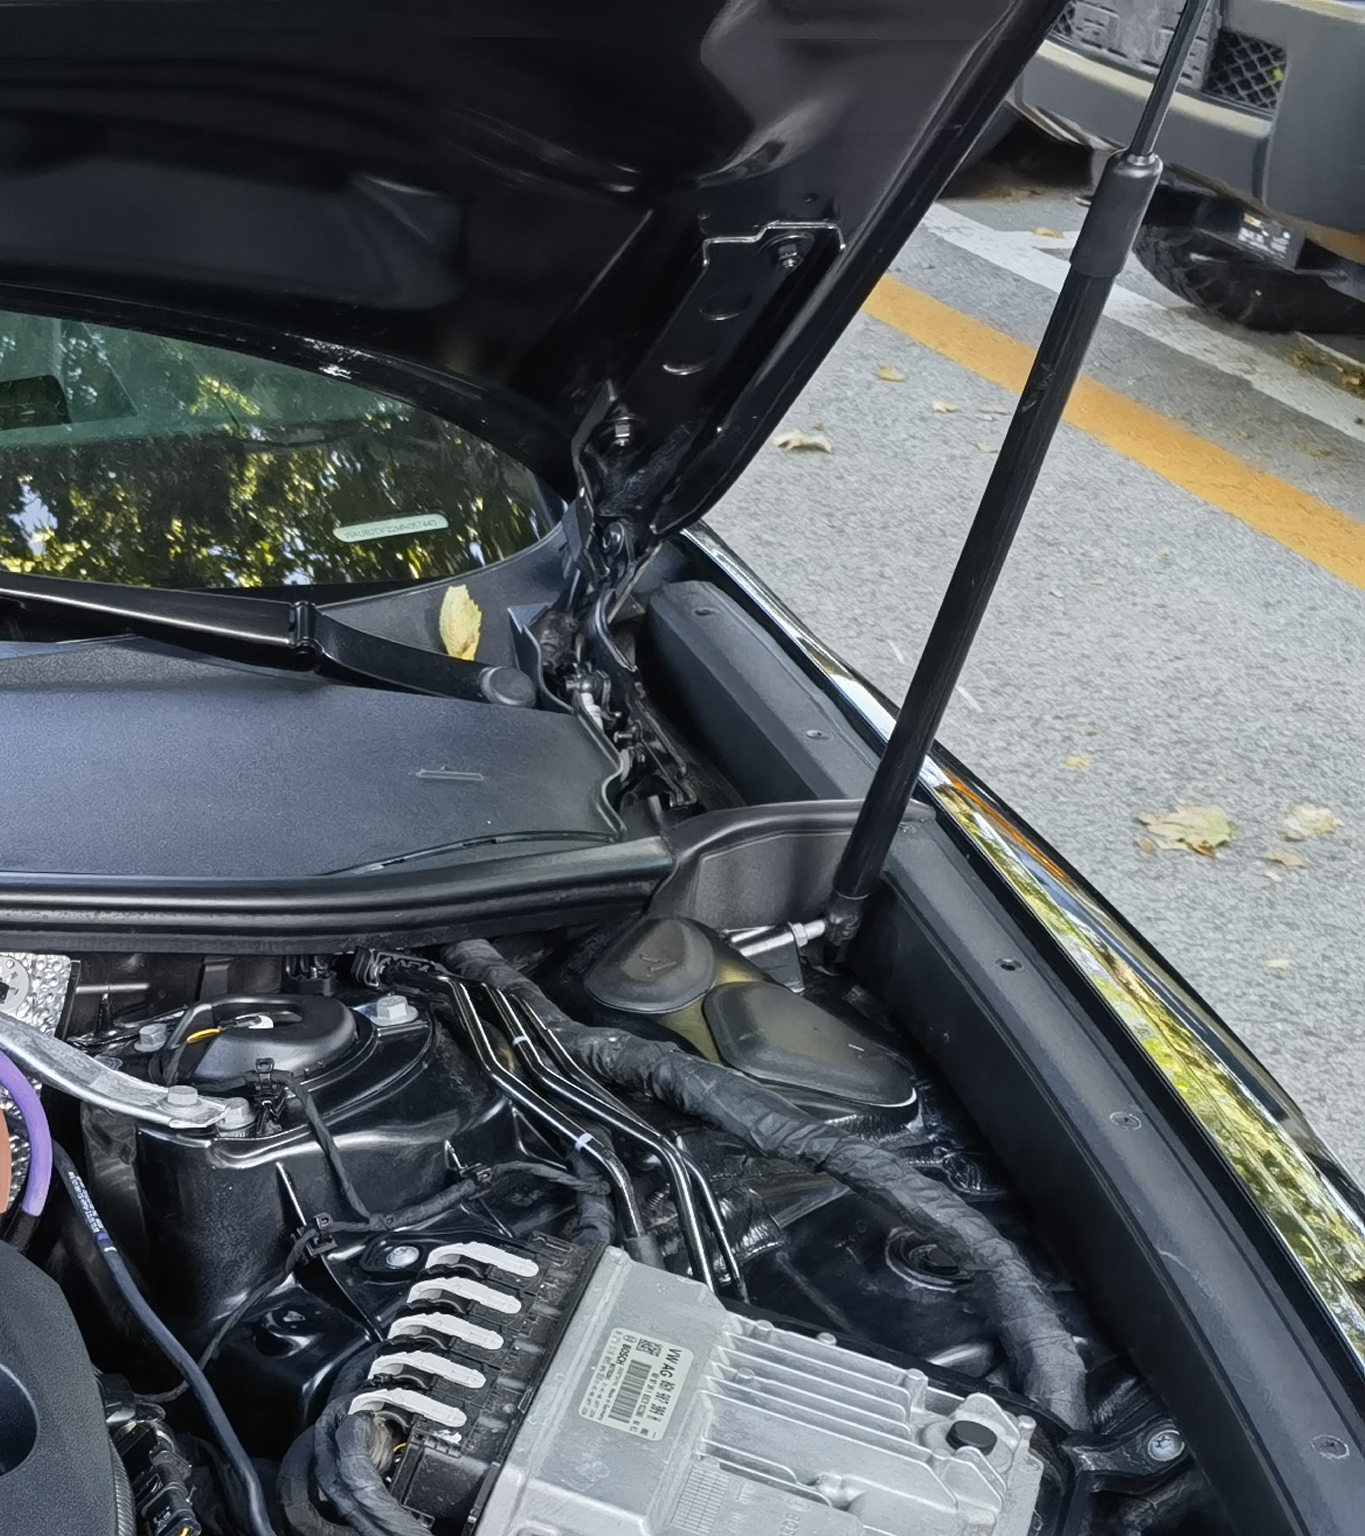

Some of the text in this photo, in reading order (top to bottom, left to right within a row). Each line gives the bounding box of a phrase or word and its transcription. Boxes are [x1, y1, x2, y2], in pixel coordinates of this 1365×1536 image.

[615, 1343, 631, 1365] BOSCH
[667, 1347, 681, 1364] VW
[658, 1362, 675, 1378] AG
